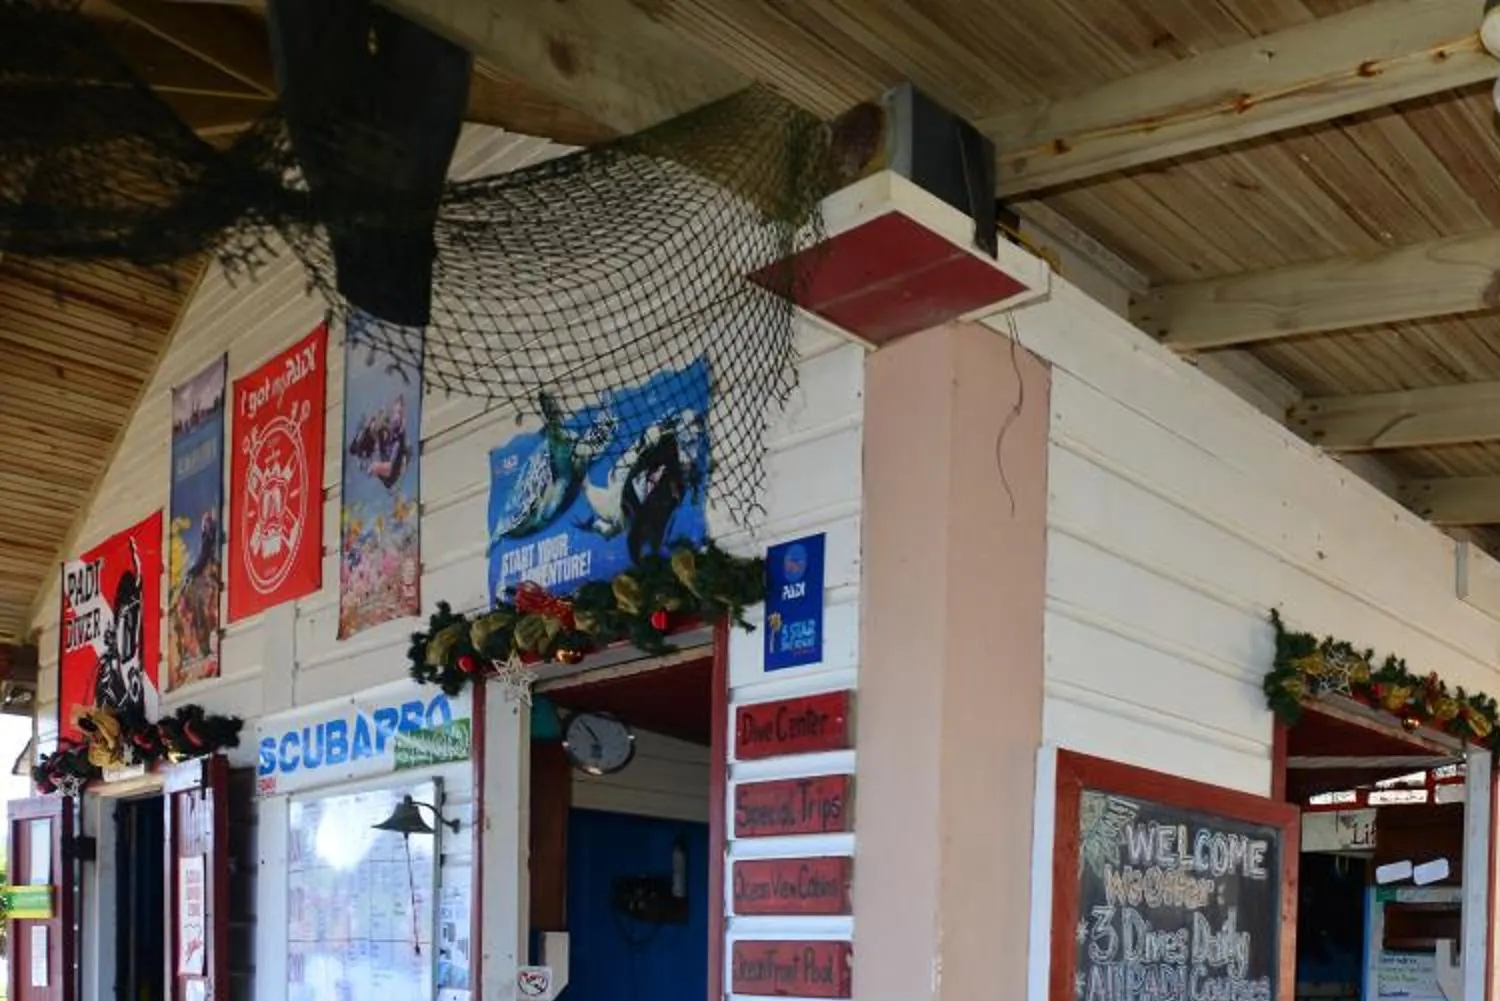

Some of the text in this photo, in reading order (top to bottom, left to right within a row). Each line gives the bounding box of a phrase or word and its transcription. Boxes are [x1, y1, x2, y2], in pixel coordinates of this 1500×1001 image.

[248, 376, 270, 419] got
[285, 342, 317, 385] PADI
[67, 560, 100, 606] PADI
[502, 543, 534, 577] START
[783, 581, 806, 600] PADI
[65, 607, 101, 650] DIVER
[258, 692, 453, 776] SCUBAPRO
[797, 780, 842, 832] Trips
[1124, 821, 1268, 880] WELCOME
[1088, 905, 1251, 977] 3 Dives Daily
